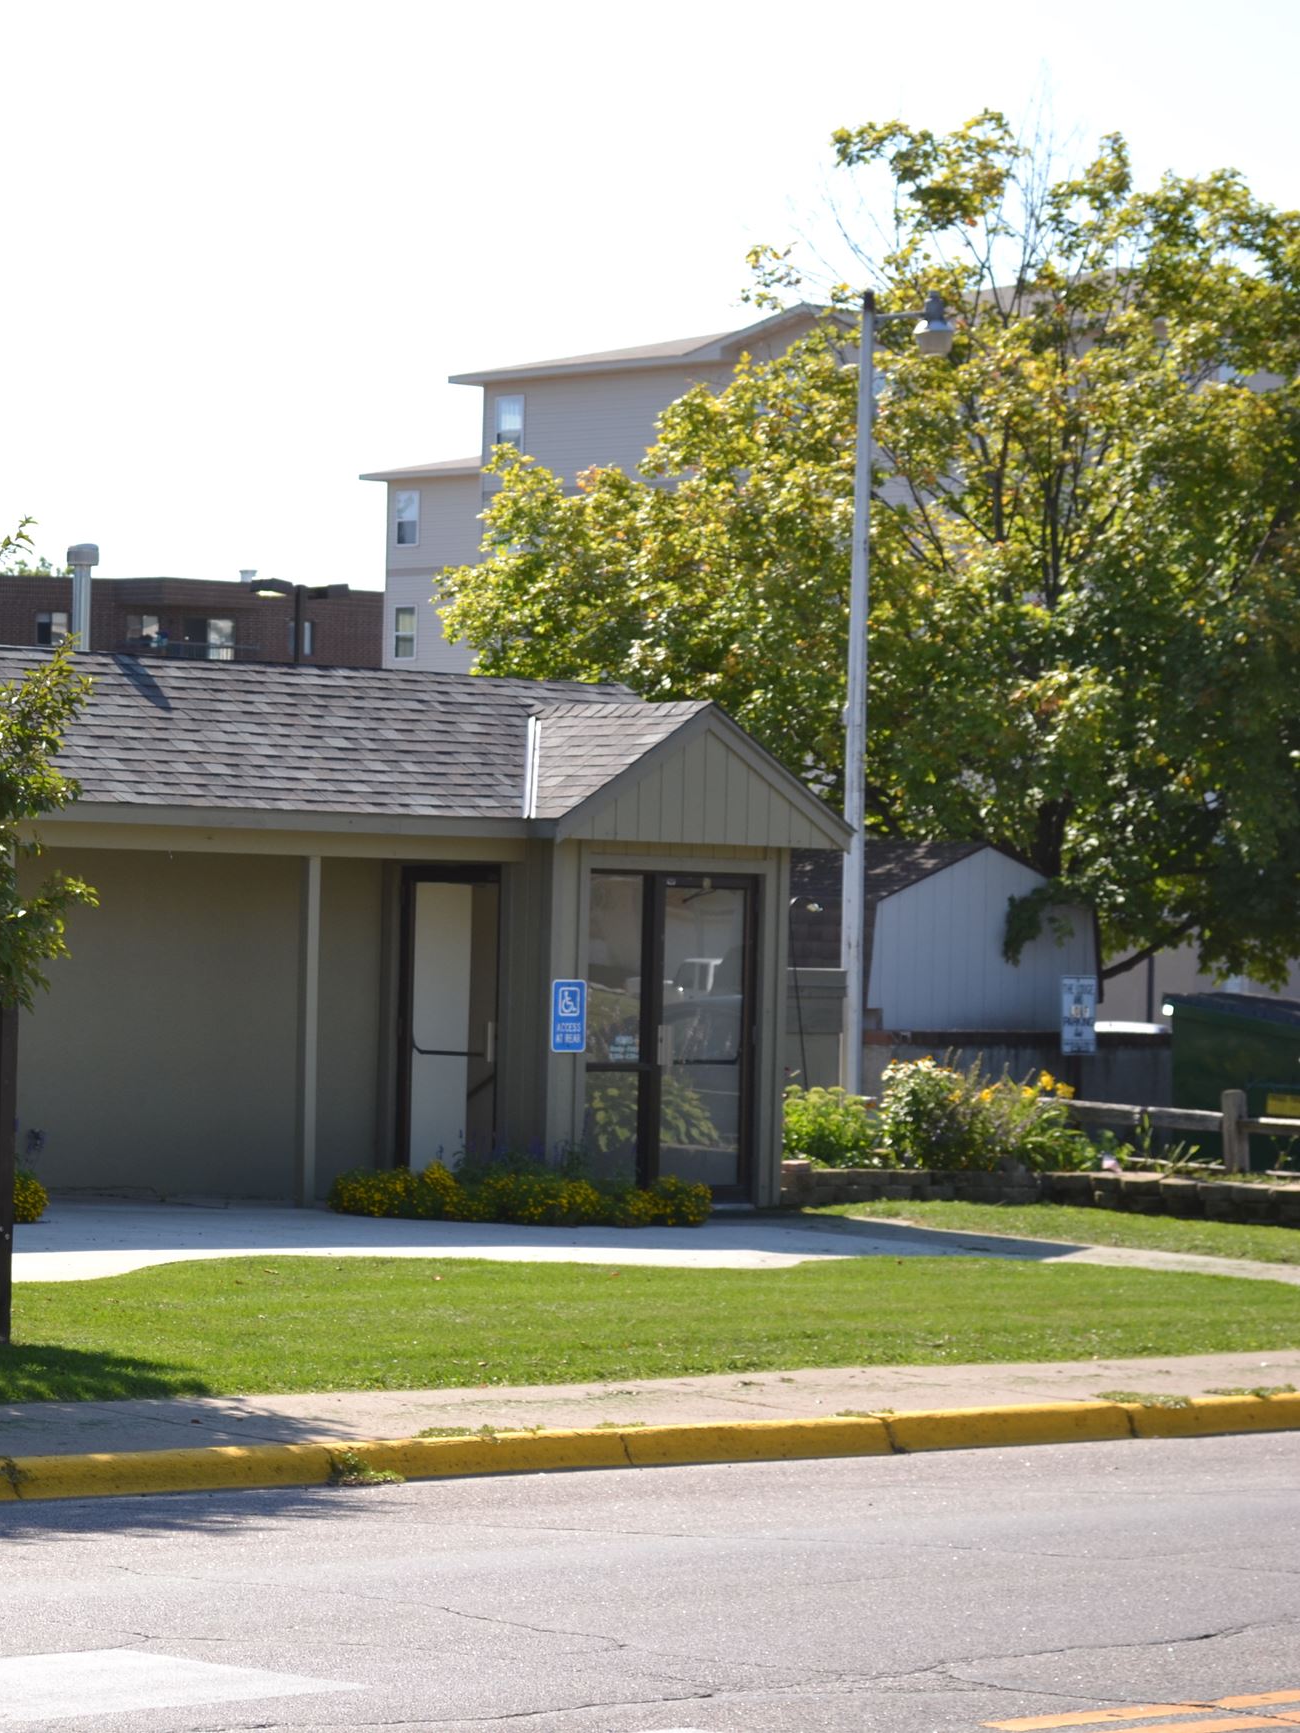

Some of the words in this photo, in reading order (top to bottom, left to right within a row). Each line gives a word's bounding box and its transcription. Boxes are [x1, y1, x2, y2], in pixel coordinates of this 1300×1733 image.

[557, 1022, 581, 1032] ACCESS
[555, 1034, 563, 1043] AT
[565, 1034, 581, 1043] REAR
